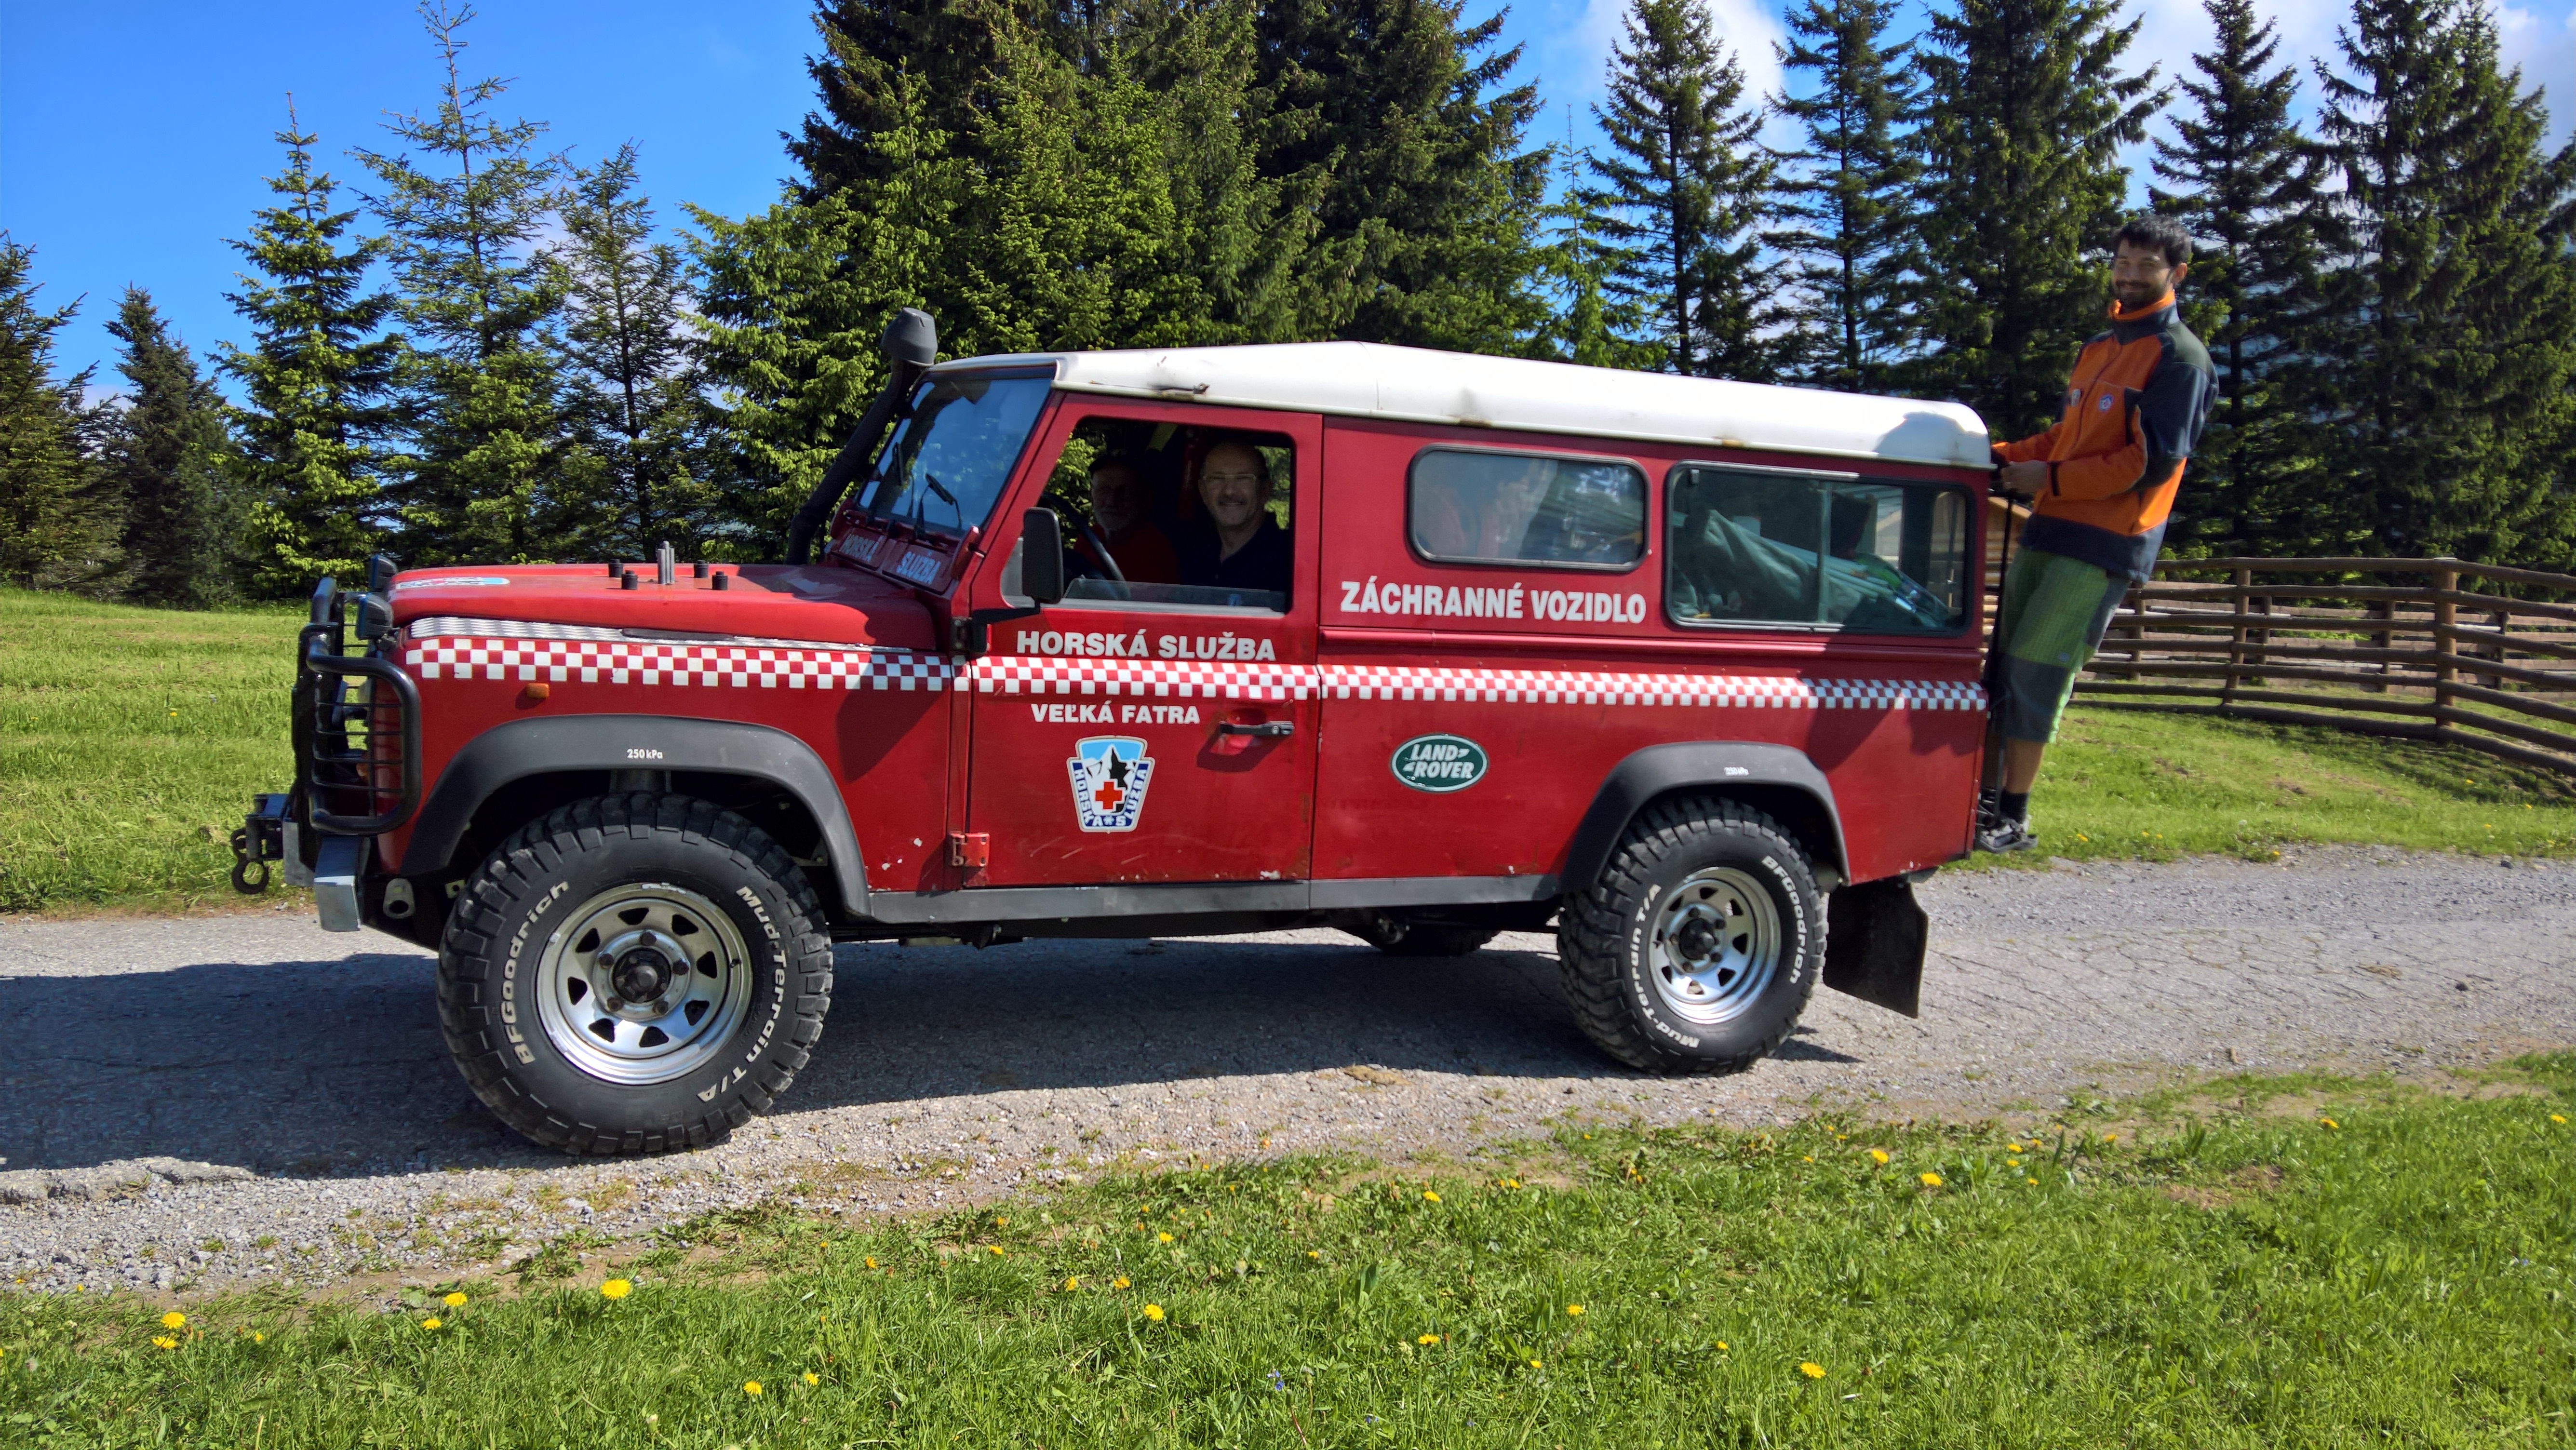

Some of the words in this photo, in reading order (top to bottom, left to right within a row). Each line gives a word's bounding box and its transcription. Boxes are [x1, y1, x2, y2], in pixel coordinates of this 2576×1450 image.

[1341, 576, 1524, 619] ZÁCHRANNÉ
[1530, 590, 1646, 624] VOZIDLO
[1017, 629, 1149, 657] HORSKÁ
[1158, 631, 1276, 661] SLUŽBA
[1031, 700, 1114, 724] VEĽKÁ
[1122, 705, 1200, 724] FATRA
[627, 748, 645, 759] 250
[646, 749, 663, 760] kPa
[1410, 744, 1459, 761] LAND
[1413, 761, 1475, 779] ROVER
[1762, 855, 1807, 984] BFGoodrich
[501, 881, 569, 1064] BFGoodrich
[697, 1066, 747, 1102] T/A
